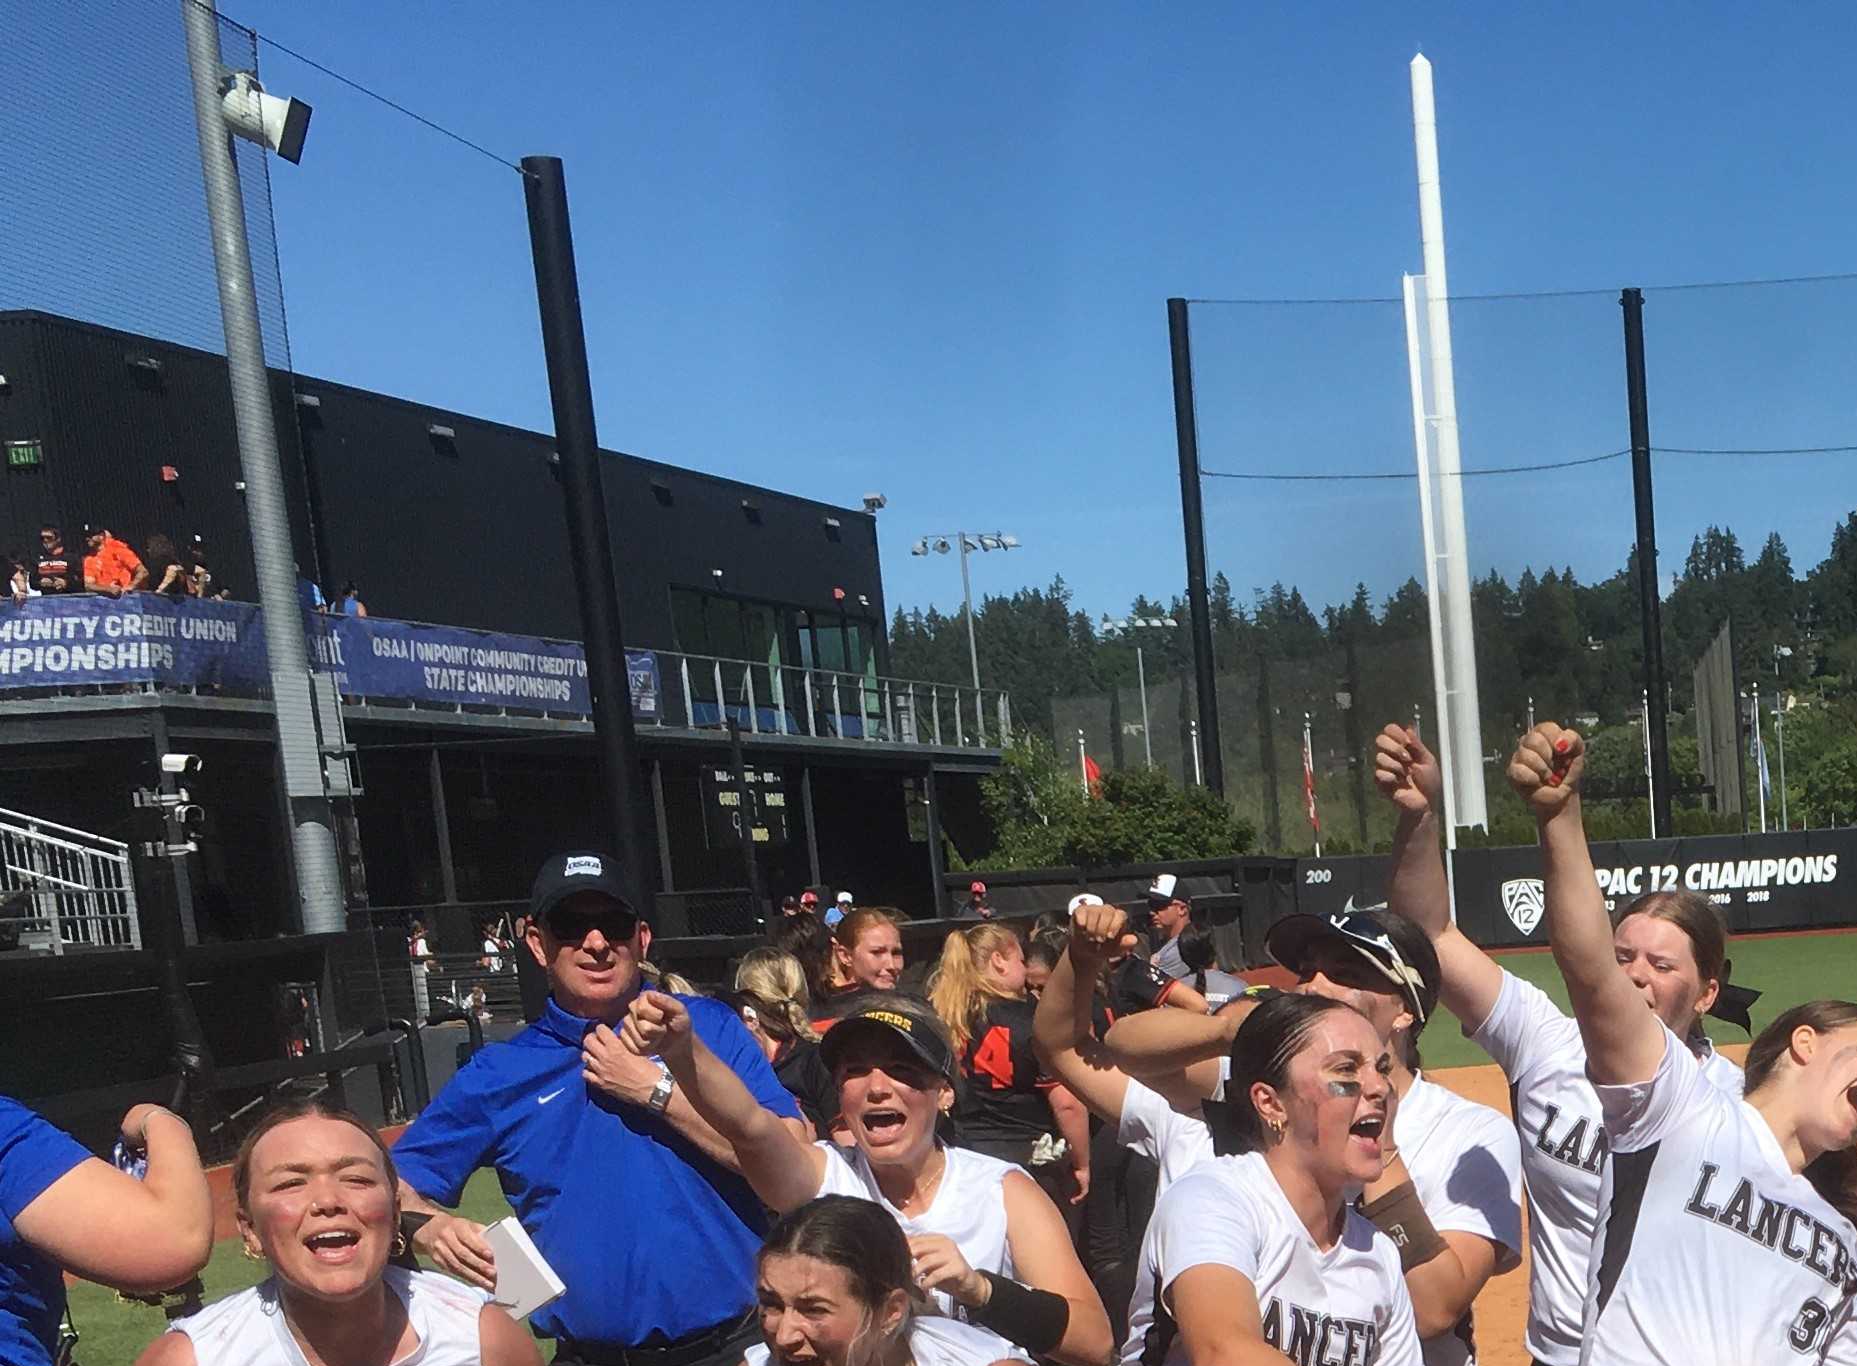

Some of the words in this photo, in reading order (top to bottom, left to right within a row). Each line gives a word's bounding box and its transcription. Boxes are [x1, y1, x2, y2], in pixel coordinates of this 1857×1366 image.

[105, 614, 176, 638] CREDIT
[180, 617, 238, 642] UNION
[372, 637, 409, 662] OSAA
[416, 642, 469, 665] ONPOINT
[470, 647, 539, 671] COMMUNITY
[537, 654, 576, 677] CREDIT
[424, 666, 467, 692] STATE
[467, 672, 571, 702] CHAMPIONSHIPS
[719, 792, 740, 807] GUEST
[765, 792, 785, 807] HOME
[1305, 869, 1332, 884] 200
[1594, 866, 1643, 896] PAC
[1650, 864, 1679, 893] 12
[1684, 854, 1838, 891] CHAMPIONS
[1502, 882, 1545, 913] PAC
[1709, 893, 1732, 906] 2016
[1746, 890, 1770, 902] 2018
[1518, 908, 1535, 925] 12
[973, 1026, 1014, 1089] 4
